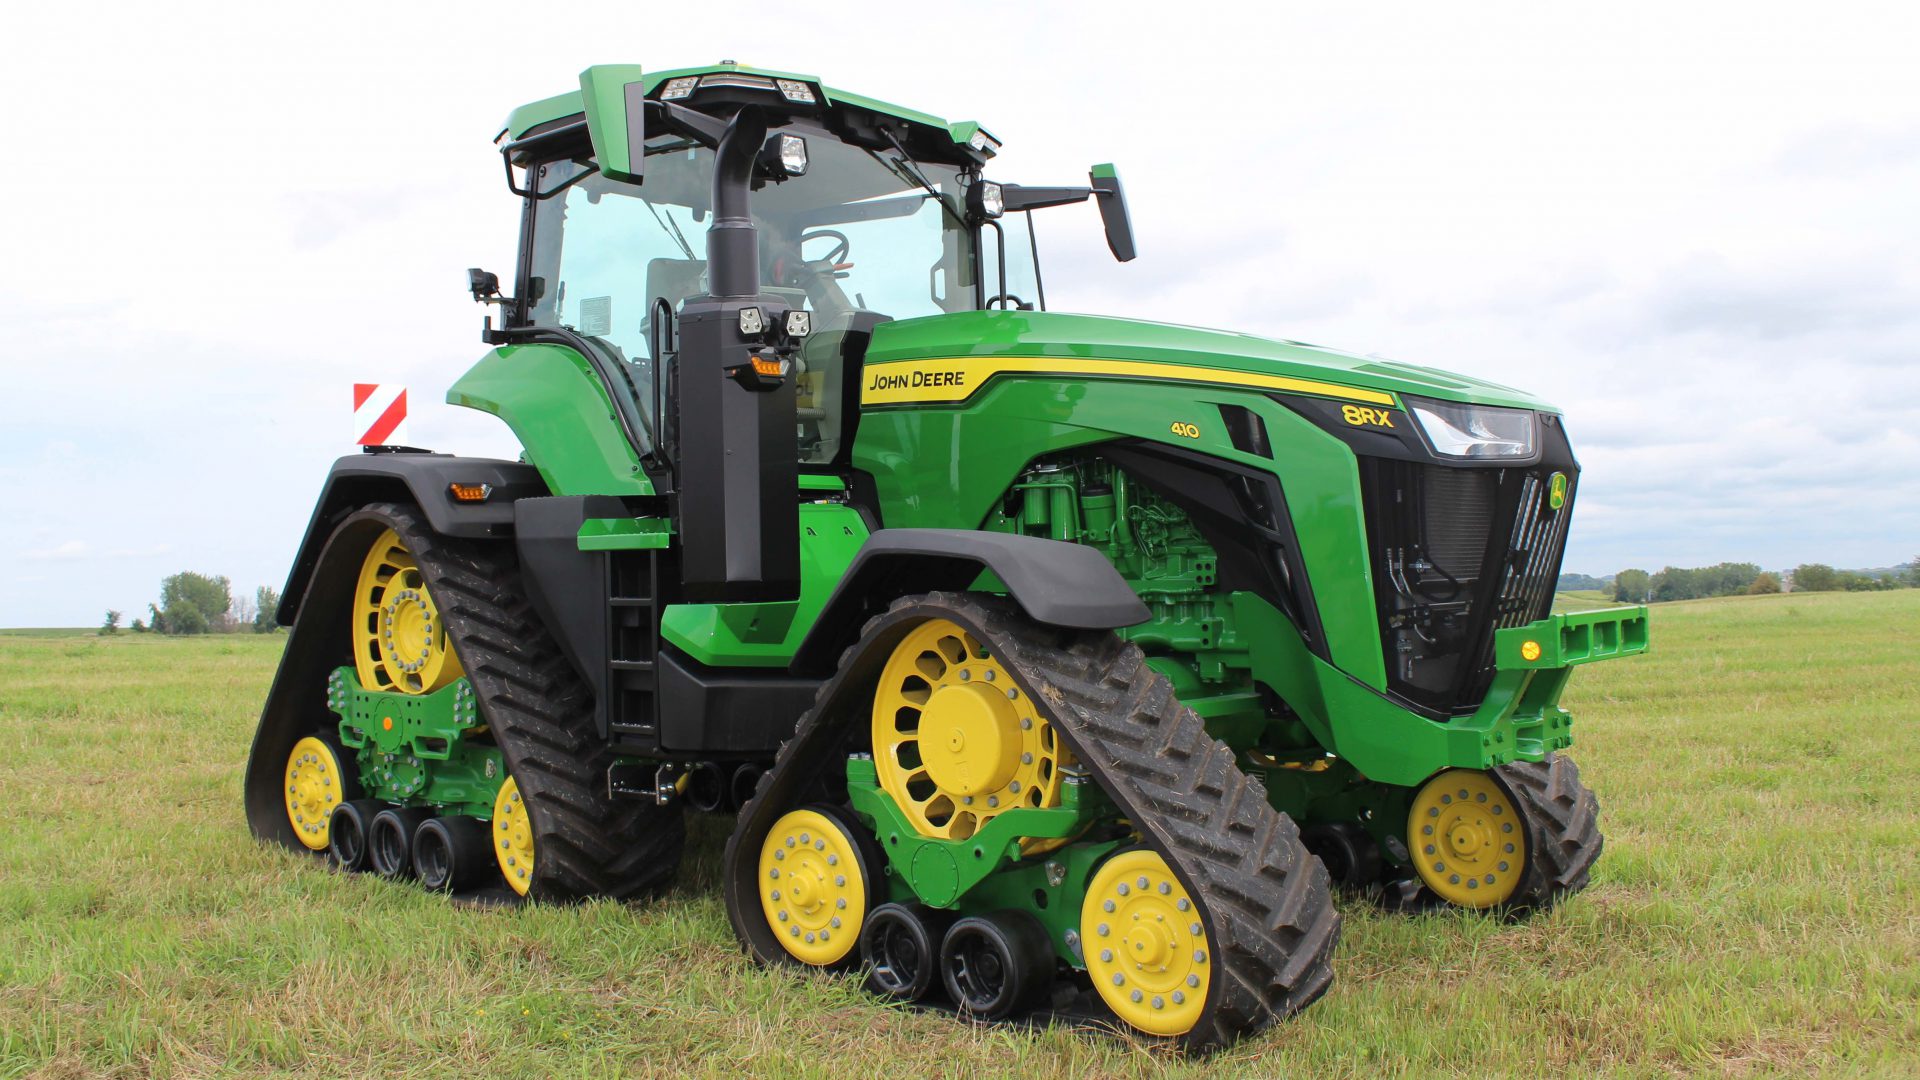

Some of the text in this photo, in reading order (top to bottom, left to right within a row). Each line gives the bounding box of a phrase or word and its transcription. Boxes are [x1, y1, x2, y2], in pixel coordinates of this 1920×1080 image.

[869, 370, 965, 390] JOHN DEERE
[1341, 404, 1395, 428] 8RX
[1170, 421, 1200, 439] 410
